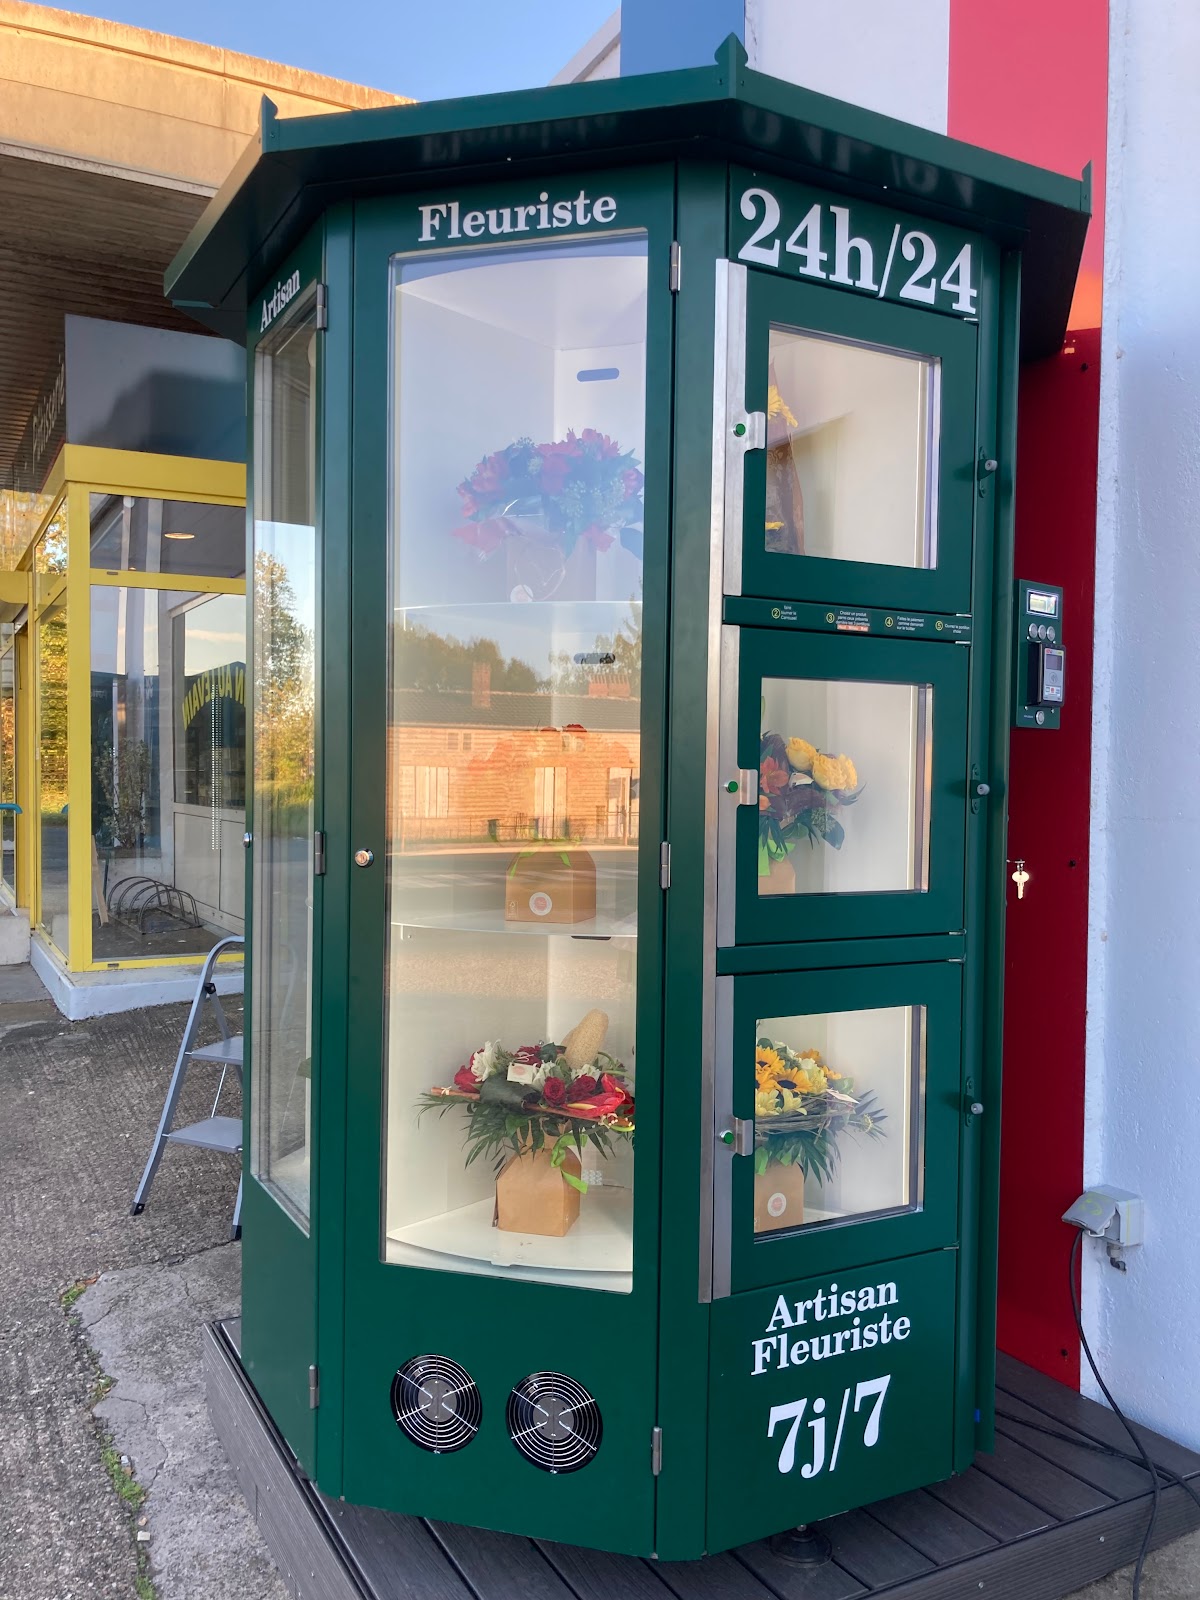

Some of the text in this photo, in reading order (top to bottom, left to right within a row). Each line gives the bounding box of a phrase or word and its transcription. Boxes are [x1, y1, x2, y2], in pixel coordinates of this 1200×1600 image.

[417, 189, 617, 242] Fleuriste
[737, 187, 978, 314] 24h/24
[258, 269, 301, 333] Artisan
[765, 1280, 899, 1332] Artisan
[750, 1312, 911, 1376] Fleuriste
[767, 1374, 891, 1479] 7j/7
